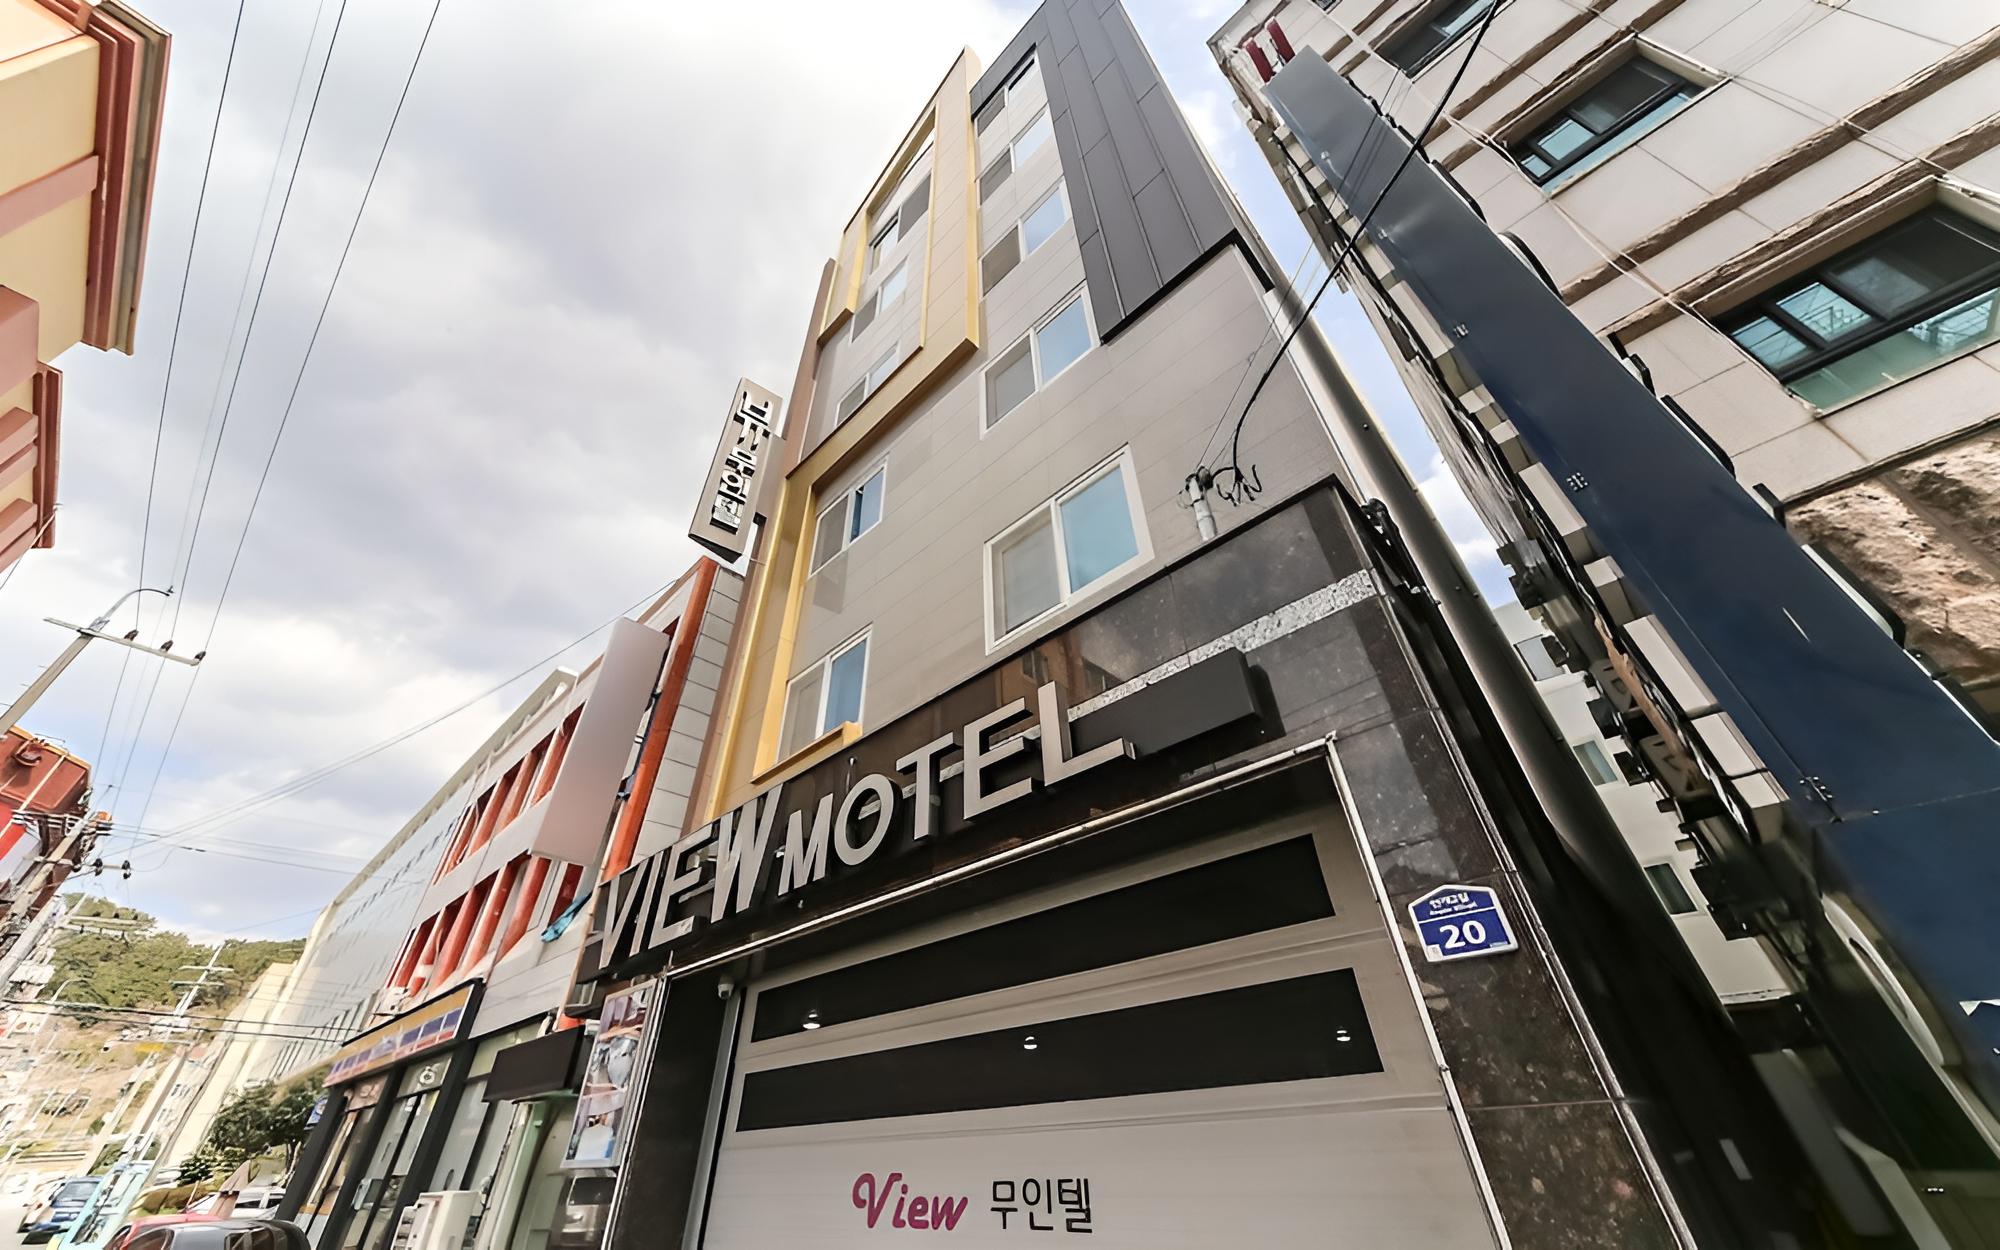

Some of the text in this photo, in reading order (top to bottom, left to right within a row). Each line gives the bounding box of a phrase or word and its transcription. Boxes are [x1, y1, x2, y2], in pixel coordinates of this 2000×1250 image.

[599, 681, 1135, 969] VIEW MOTEL
[1439, 920, 1486, 949] 20
[852, 1172, 1093, 1233] View 무인텔
